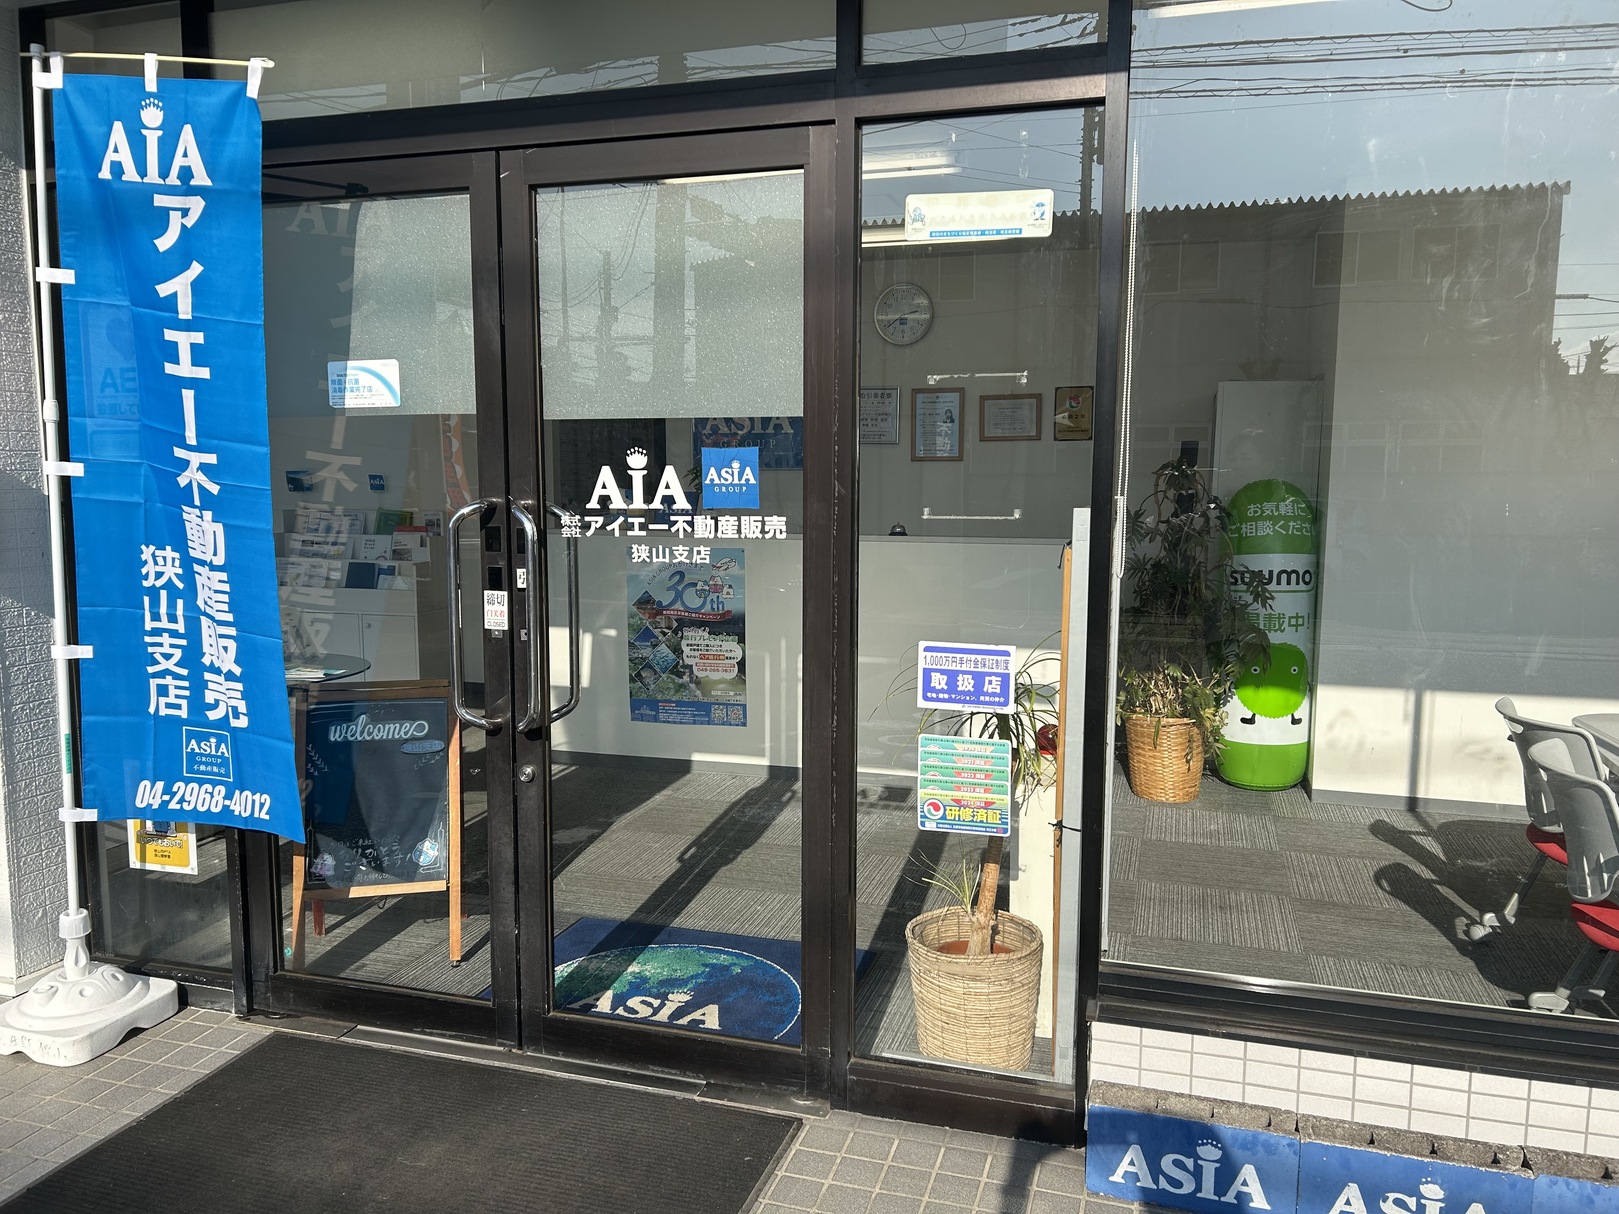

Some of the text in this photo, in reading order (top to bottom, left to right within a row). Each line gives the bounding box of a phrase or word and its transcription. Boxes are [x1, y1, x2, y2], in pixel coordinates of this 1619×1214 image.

[153, 193, 249, 729] アイエー不動産販売
[585, 446, 693, 510] AIA
[704, 460, 757, 485] ASIA
[1247, 502, 1306, 517] お気軽に
[584, 515, 788, 539] アイエー不動産販売
[631, 544, 712, 564] 狭山支店
[486, 592, 506, 607] 締切
[139, 543, 191, 720] 狭山支店
[923, 654, 1010, 671] 1,000万円手付金保証制度
[930, 672, 1002, 693] 取扱店
[329, 714, 429, 742] welcome
[186, 736, 230, 757] ASIA
[193, 764, 226, 775] 不動産販売
[195, 756, 222, 765] GROUP
[135, 779, 271, 821] 04-2968-4012
[945, 806, 1002, 823] 研修済証
[566, 988, 722, 1030] ASIA
[1108, 1139, 1272, 1211] ASIA
